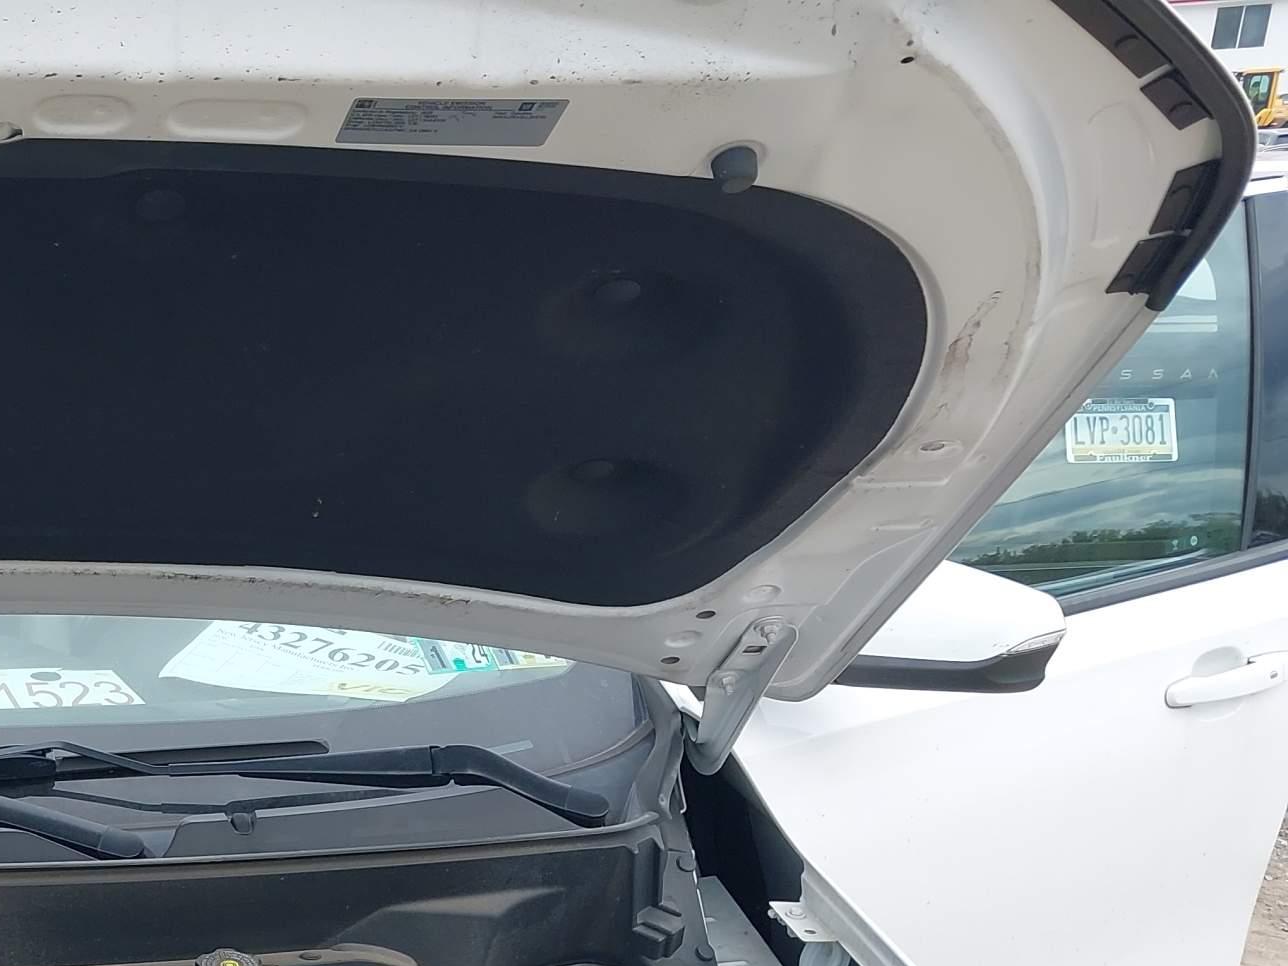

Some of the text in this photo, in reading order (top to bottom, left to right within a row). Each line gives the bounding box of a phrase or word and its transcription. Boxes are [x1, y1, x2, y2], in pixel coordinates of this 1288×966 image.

[1119, 368, 1219, 381] SSAN
[1073, 413, 1167, 446] LVP 3081
[1096, 453, 1153, 463] Faulkner
[239, 623, 425, 676] 43276205
